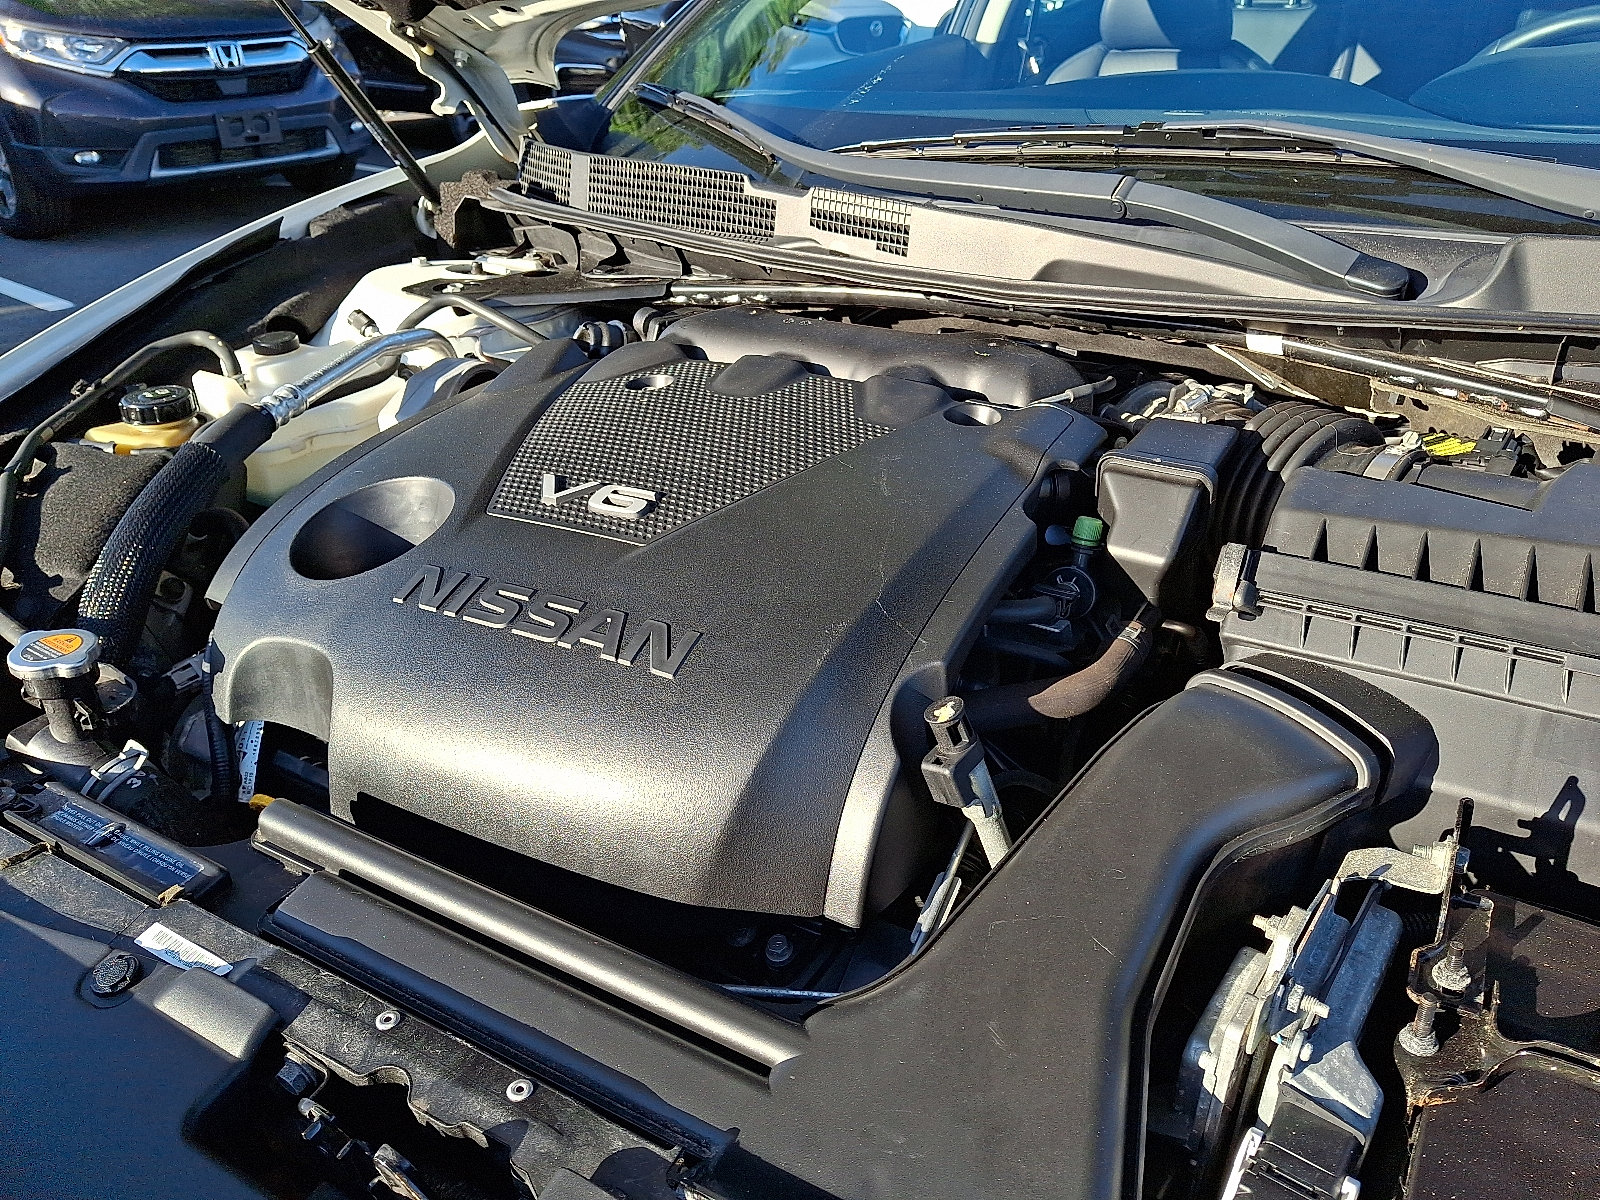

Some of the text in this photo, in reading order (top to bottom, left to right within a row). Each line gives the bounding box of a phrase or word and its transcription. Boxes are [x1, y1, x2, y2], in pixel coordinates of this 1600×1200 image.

[541, 473, 660, 522] V6
[393, 564, 703, 679] NISSAN
[86, 817, 96, 825] OUT
[159, 852, 177, 864] ENGINE
[176, 860, 185, 868] OIL
